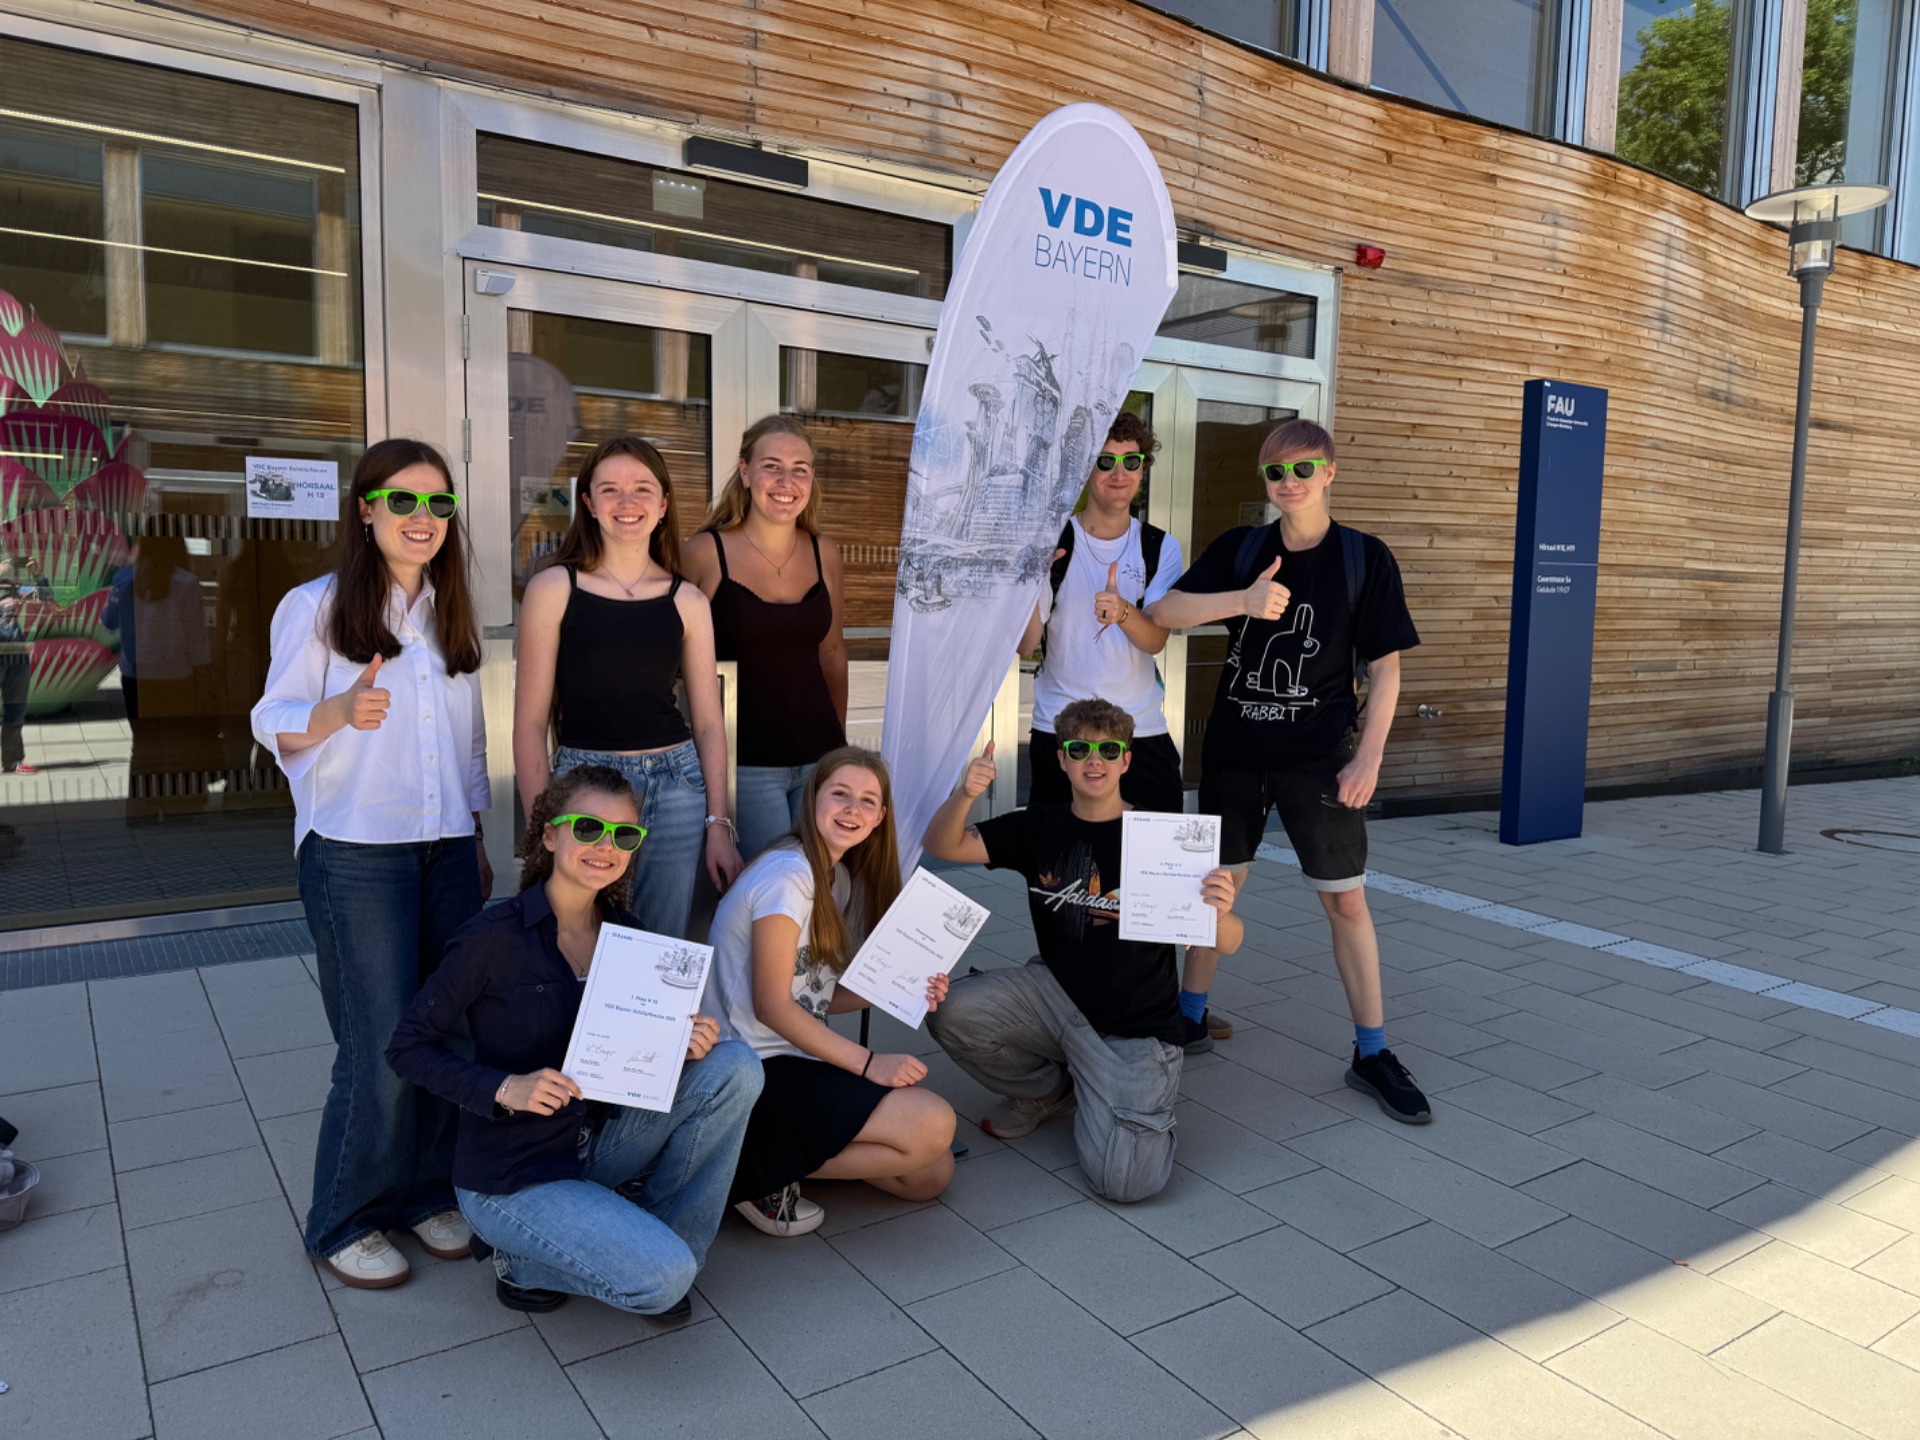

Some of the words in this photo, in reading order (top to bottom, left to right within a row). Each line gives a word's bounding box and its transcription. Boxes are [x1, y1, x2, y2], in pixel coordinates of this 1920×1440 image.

[1038, 187, 1133, 248] VDE
[1034, 233, 1132, 287] BAYERN
[1546, 394, 1575, 417] FAU
[296, 480, 336, 491] HÖRSAAL
[1241, 704, 1301, 723] RABBIT
[1030, 878, 1120, 912] Adidas
